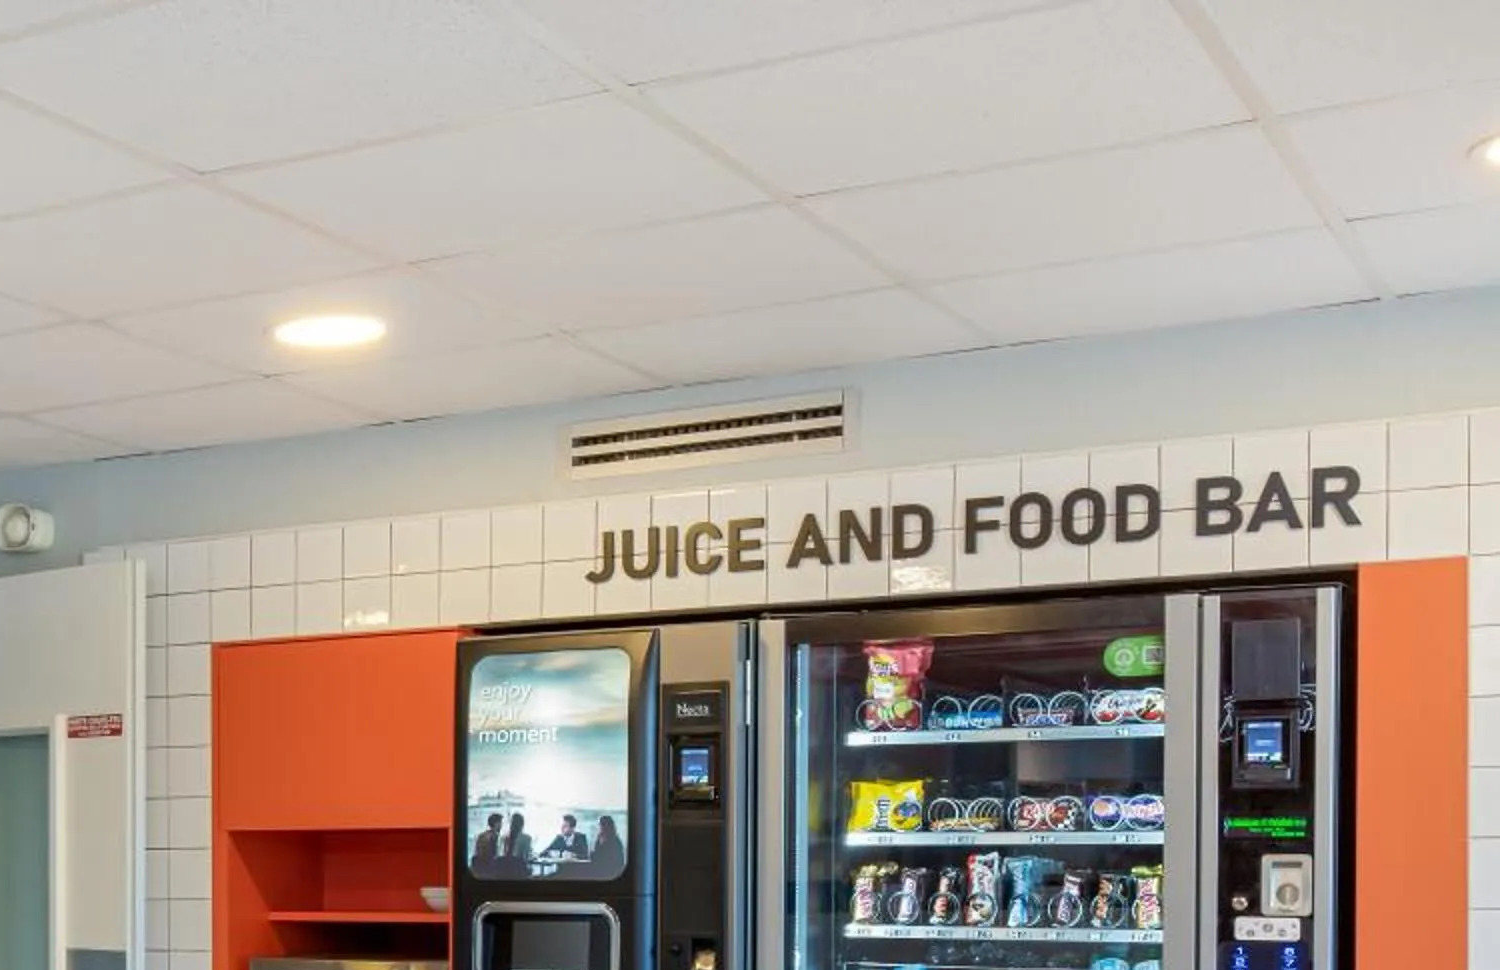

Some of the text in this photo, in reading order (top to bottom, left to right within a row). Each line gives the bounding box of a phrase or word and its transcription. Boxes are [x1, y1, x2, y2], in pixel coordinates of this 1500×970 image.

[585, 466, 1362, 584] JUICE AND FOOD BAR
[482, 681, 533, 705] enjoy
[480, 726, 558, 744] moment
